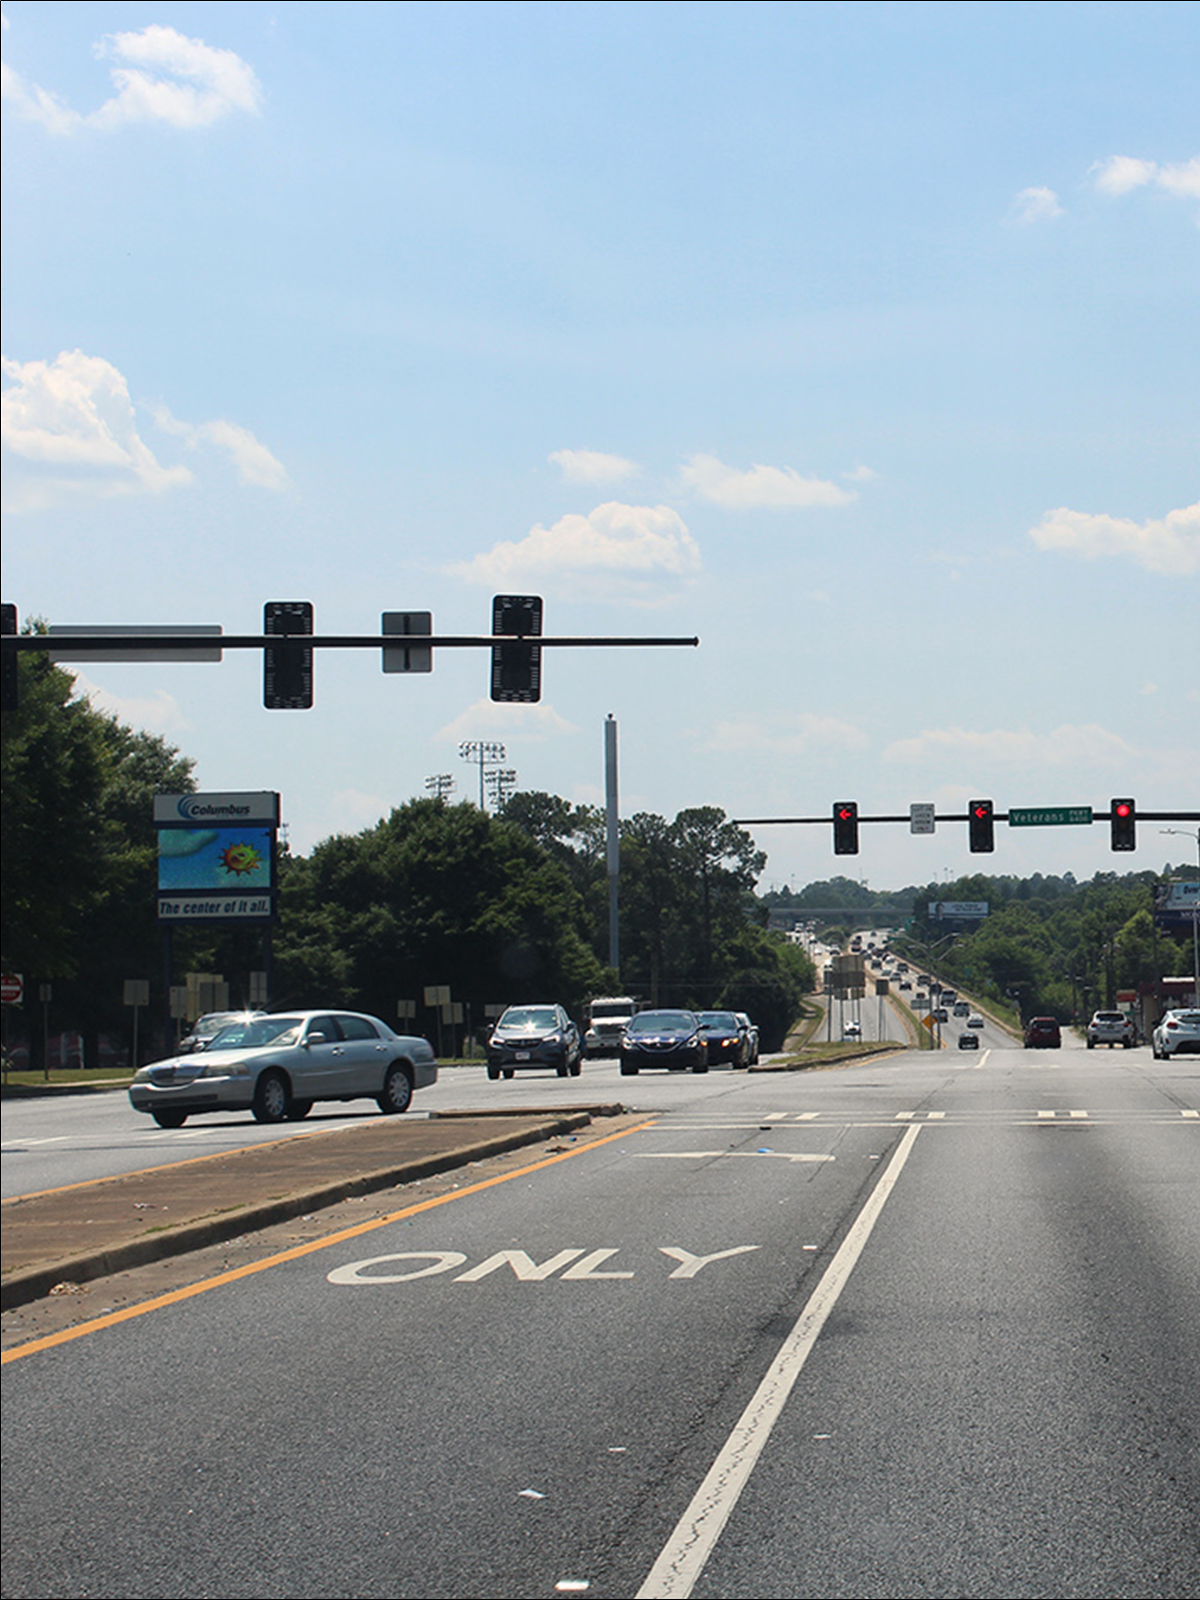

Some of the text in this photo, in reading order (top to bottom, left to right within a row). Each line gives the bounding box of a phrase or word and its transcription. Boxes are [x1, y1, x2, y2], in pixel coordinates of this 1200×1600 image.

[191, 804, 250, 816] Columbus
[1013, 812, 1064, 822] Veterans
[160, 902, 180, 914] The
[183, 902, 221, 914] center
[223, 901, 236, 913] of
[250, 900, 269, 912] all.
[326, 1244, 762, 1285] ONLY
